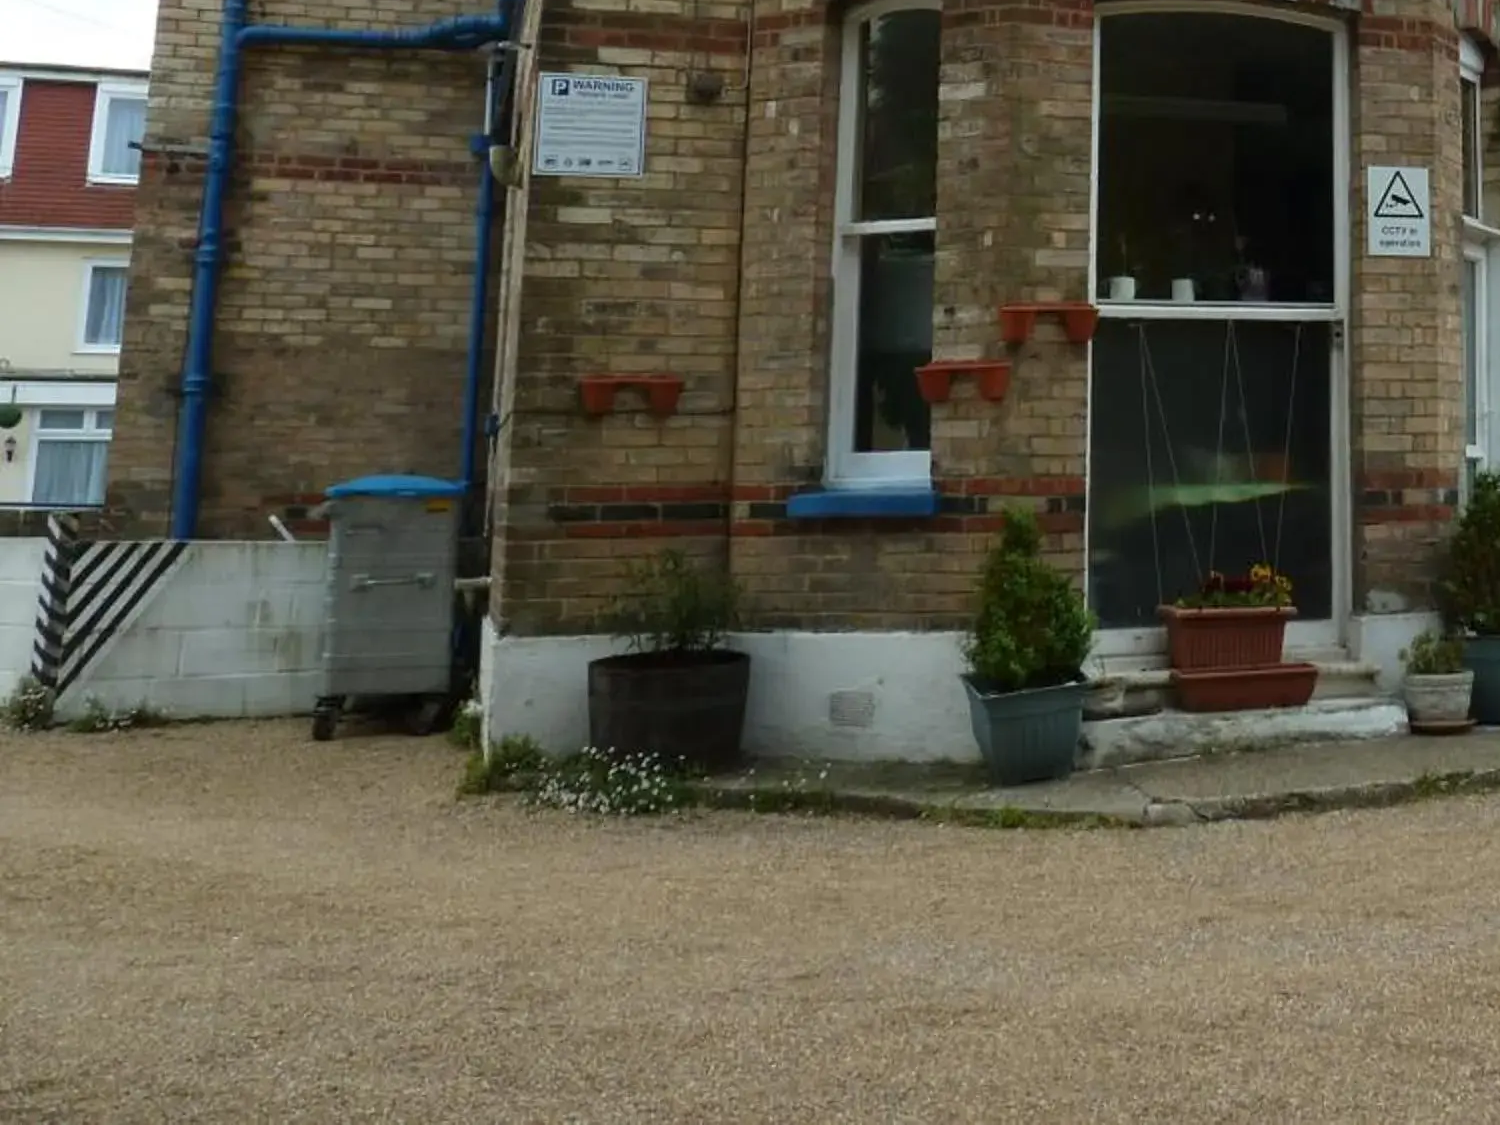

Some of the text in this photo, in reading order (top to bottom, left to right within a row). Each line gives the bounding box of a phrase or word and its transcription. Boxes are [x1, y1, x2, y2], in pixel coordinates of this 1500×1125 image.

[554, 79, 567, 94] P
[573, 80, 634, 92] WARNING
[1381, 226, 1407, 236] CCTV
